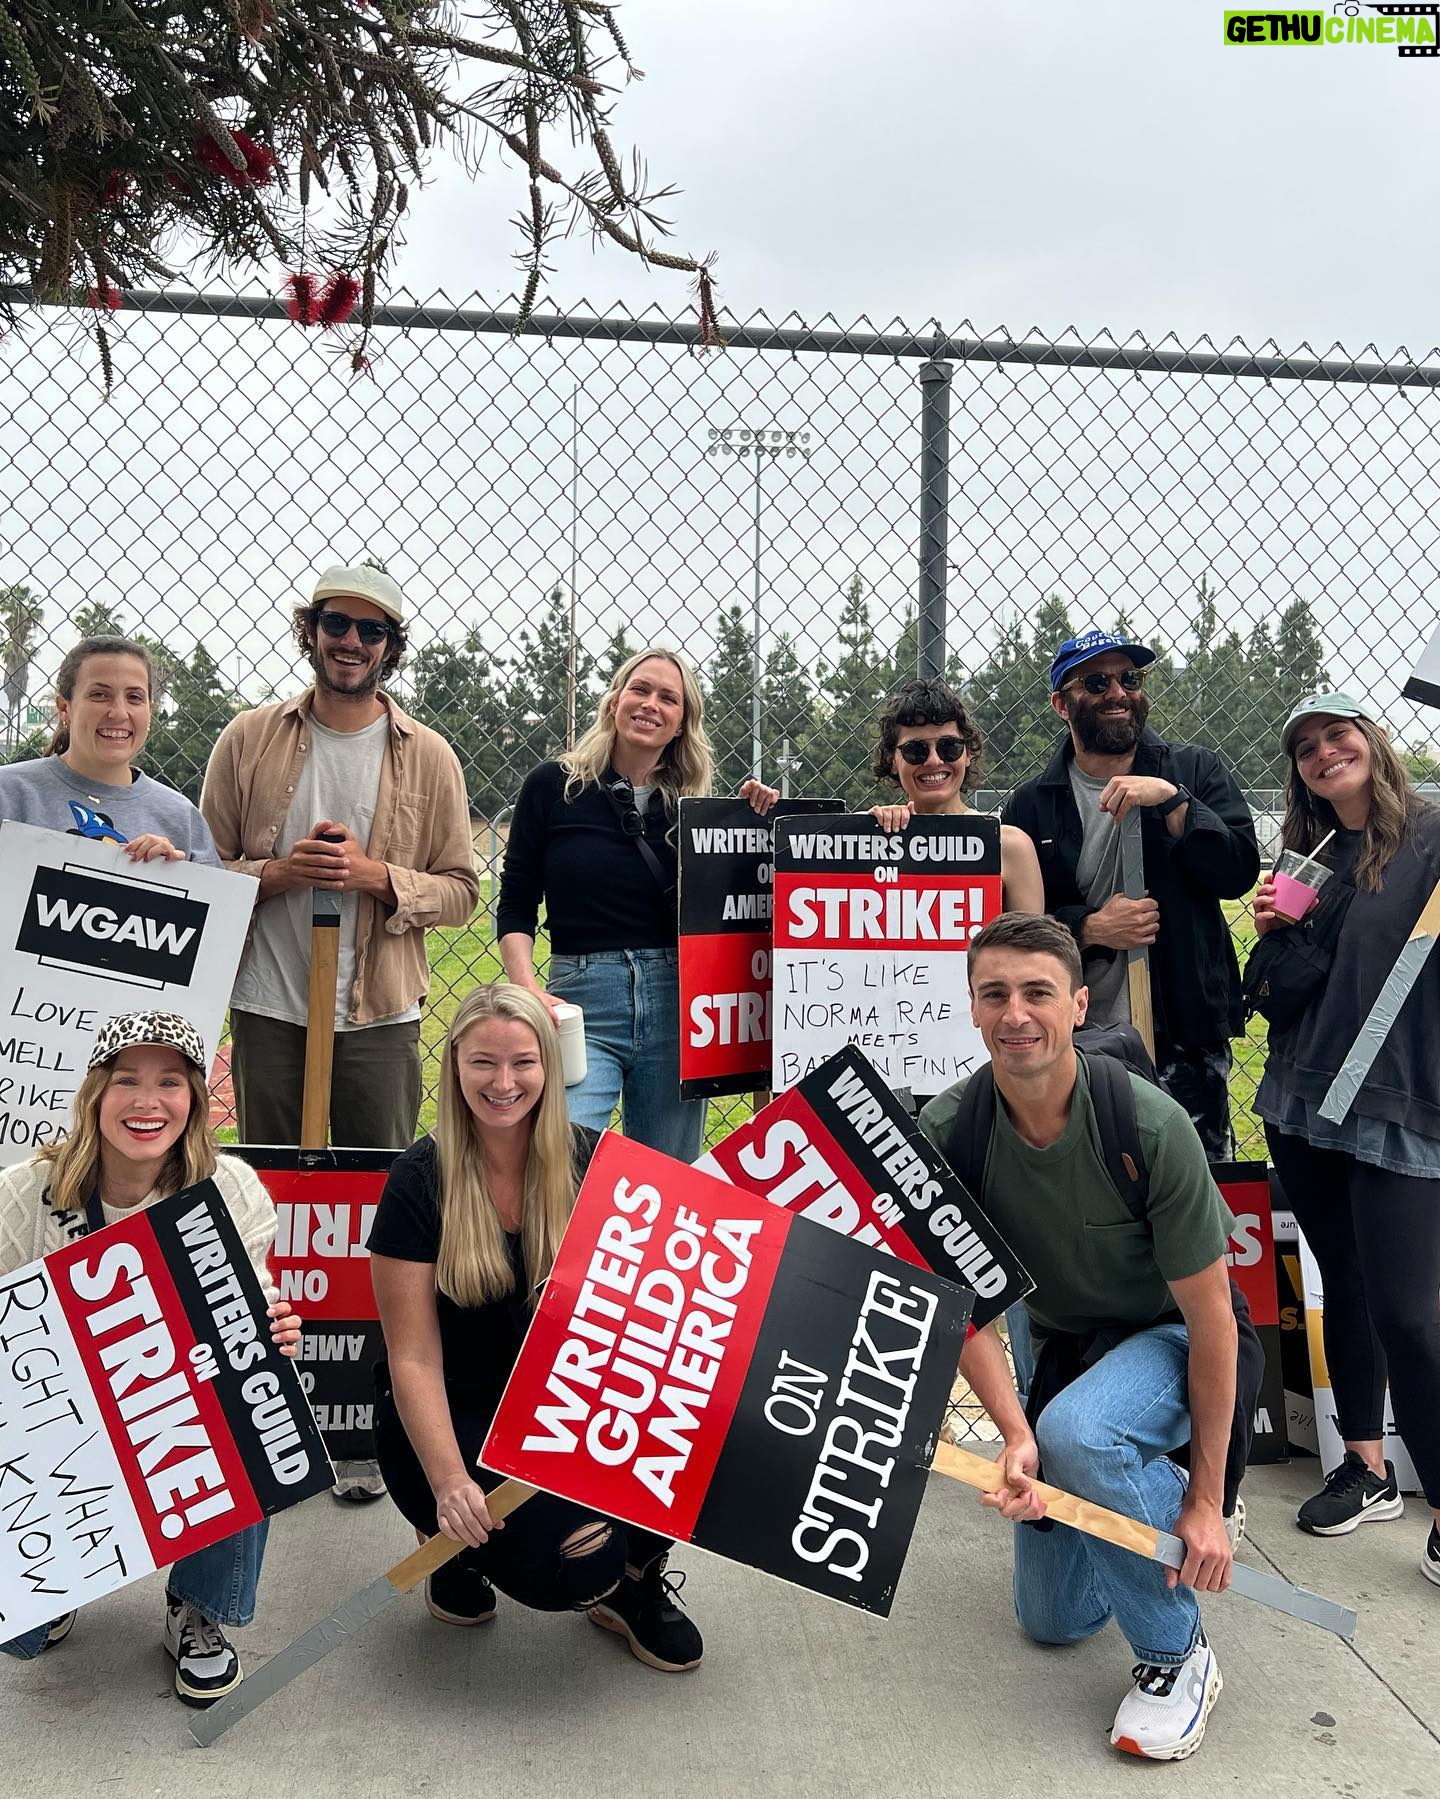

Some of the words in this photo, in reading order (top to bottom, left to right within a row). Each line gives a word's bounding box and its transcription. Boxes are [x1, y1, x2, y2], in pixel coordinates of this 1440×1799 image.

[789, 834, 904, 861] WRITERS
[909, 836, 985, 861] GUILD
[874, 866, 899, 883] ON
[36, 894, 196, 956] WGAW
[788, 887, 985, 940] STRIKE!
[786, 958, 844, 994] IT'S
[863, 963, 929, 988] LIKE
[11, 987, 98, 1031] LOVE
[784, 1003, 880, 1030] NORMA
[896, 1001, 951, 1025] RAE
[847, 1033, 919, 1048] MEETS
[903, 1055, 975, 1078] FINK
[827, 1065, 944, 1210] WRITERS
[928, 1203, 1008, 1300] GUILD
[871, 1192, 906, 1230] ON
[280, 1269, 329, 1301] ON
[520, 1175, 662, 1454] WRITERS
[585, 1268, 686, 1467] GUILD
[664, 1205, 708, 1271] OF
[175, 1201, 267, 1371] WRITERS
[241, 1370, 310, 1485] GUILD
[188, 1342, 221, 1384] ON
[631, 1218, 764, 1509] AMERICA
[69, 1242, 236, 1540] STRIKE!
[763, 1349, 829, 1436] ON
[0, 1272, 84, 1433] RIGHT
[49, 1430, 128, 1580] WHAT
[791, 1269, 939, 1582] STRIKE
